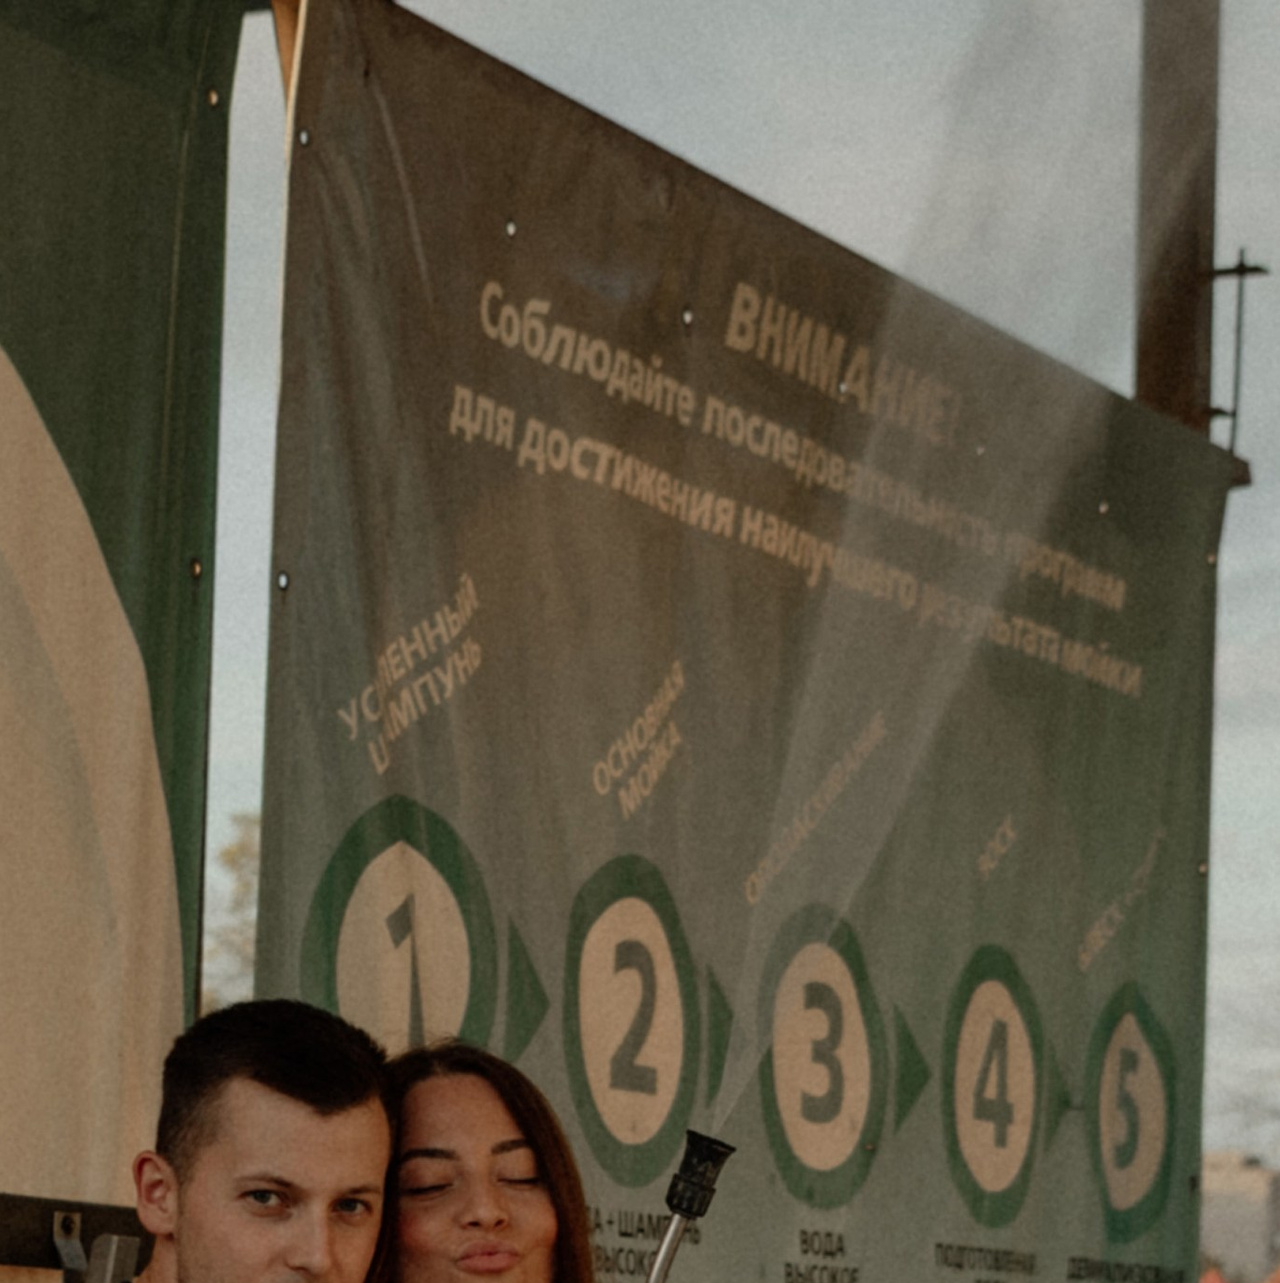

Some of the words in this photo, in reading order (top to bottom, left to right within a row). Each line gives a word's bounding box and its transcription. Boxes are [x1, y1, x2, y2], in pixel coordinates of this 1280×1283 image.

[479, 279, 695, 428] Соблюдайте
[448, 384, 516, 451] для
[515, 416, 737, 540] достижения
[384, 890, 426, 1048] 1
[609, 938, 658, 1096] 2
[800, 981, 843, 1123] 3
[973, 1020, 1013, 1148] 4
[1113, 1047, 1139, 1171] 5
[799, 1228, 846, 1259] ВОДА
